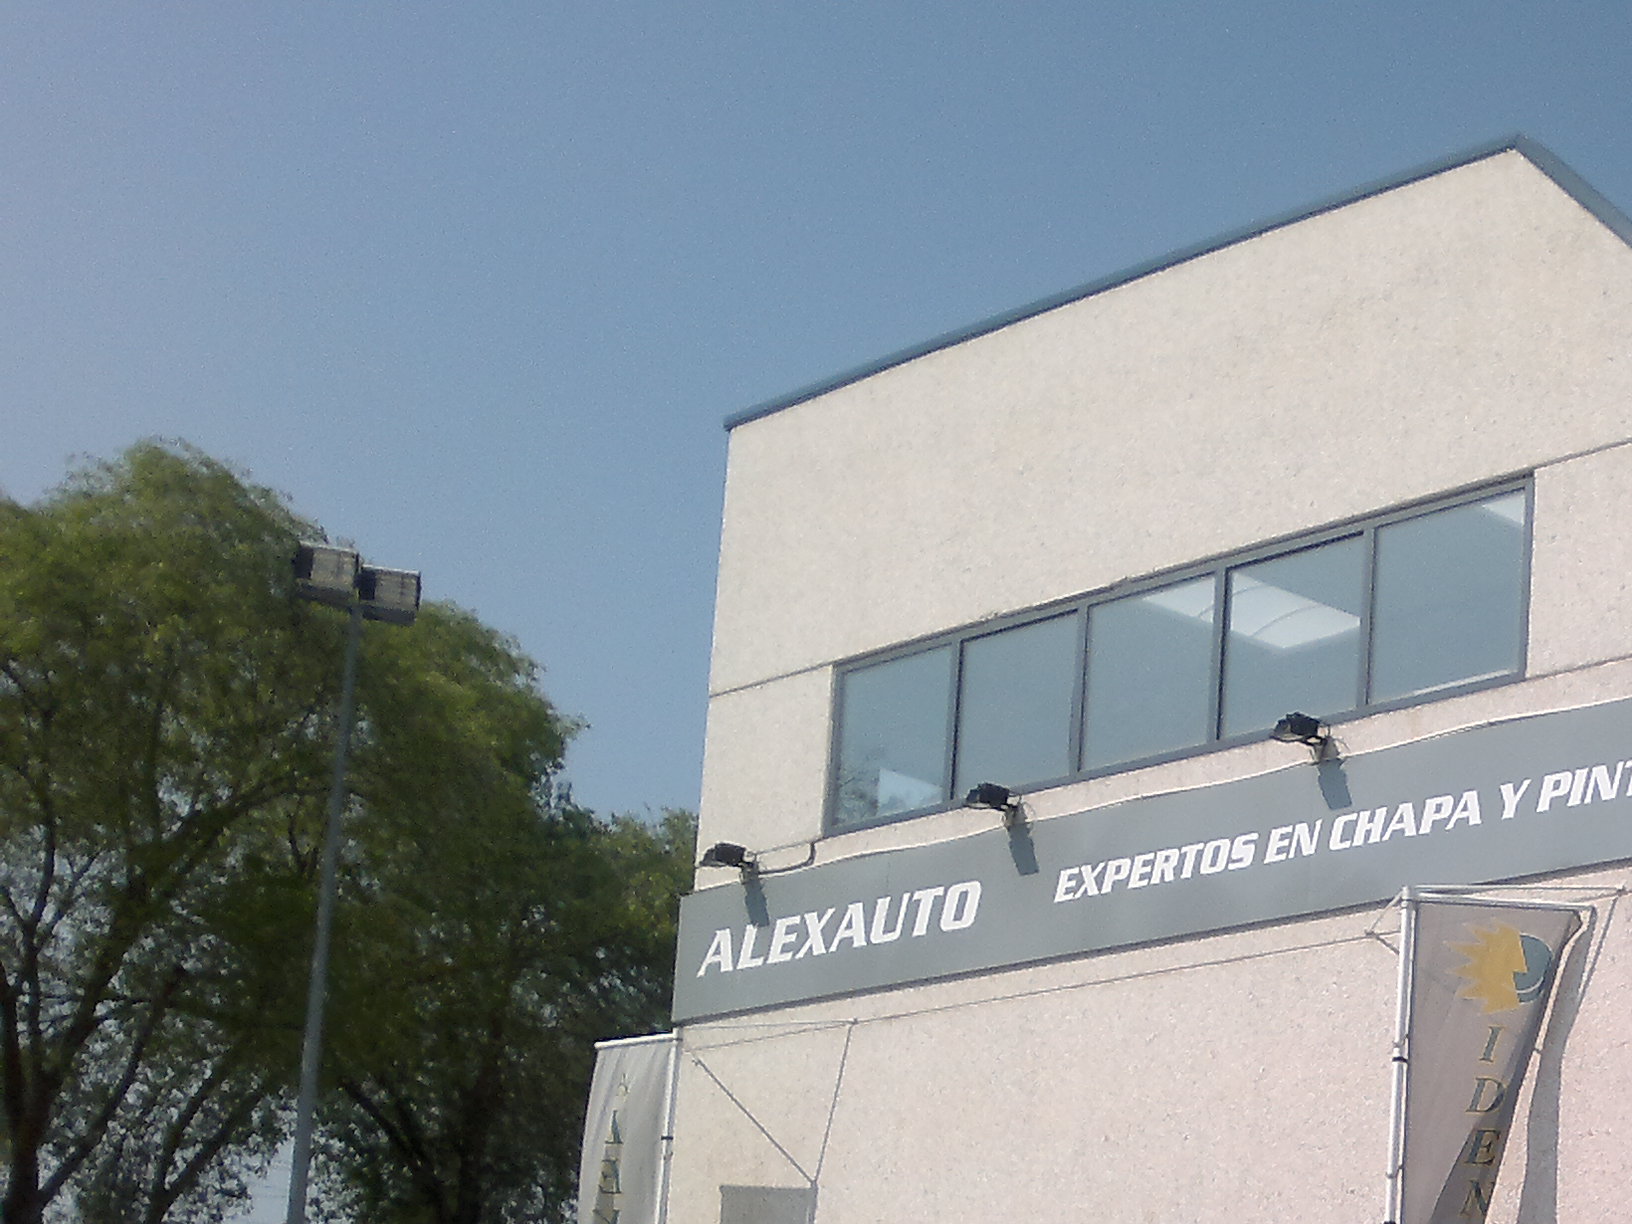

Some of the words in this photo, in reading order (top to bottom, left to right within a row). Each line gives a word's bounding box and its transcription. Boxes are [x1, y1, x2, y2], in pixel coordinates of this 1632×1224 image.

[1053, 832, 1258, 903] EXPERTOS
[1264, 819, 1322, 863] EN
[1327, 795, 1484, 852] CHAPA
[1498, 779, 1531, 821] Y
[695, 880, 983, 977] ALEXAUTO
